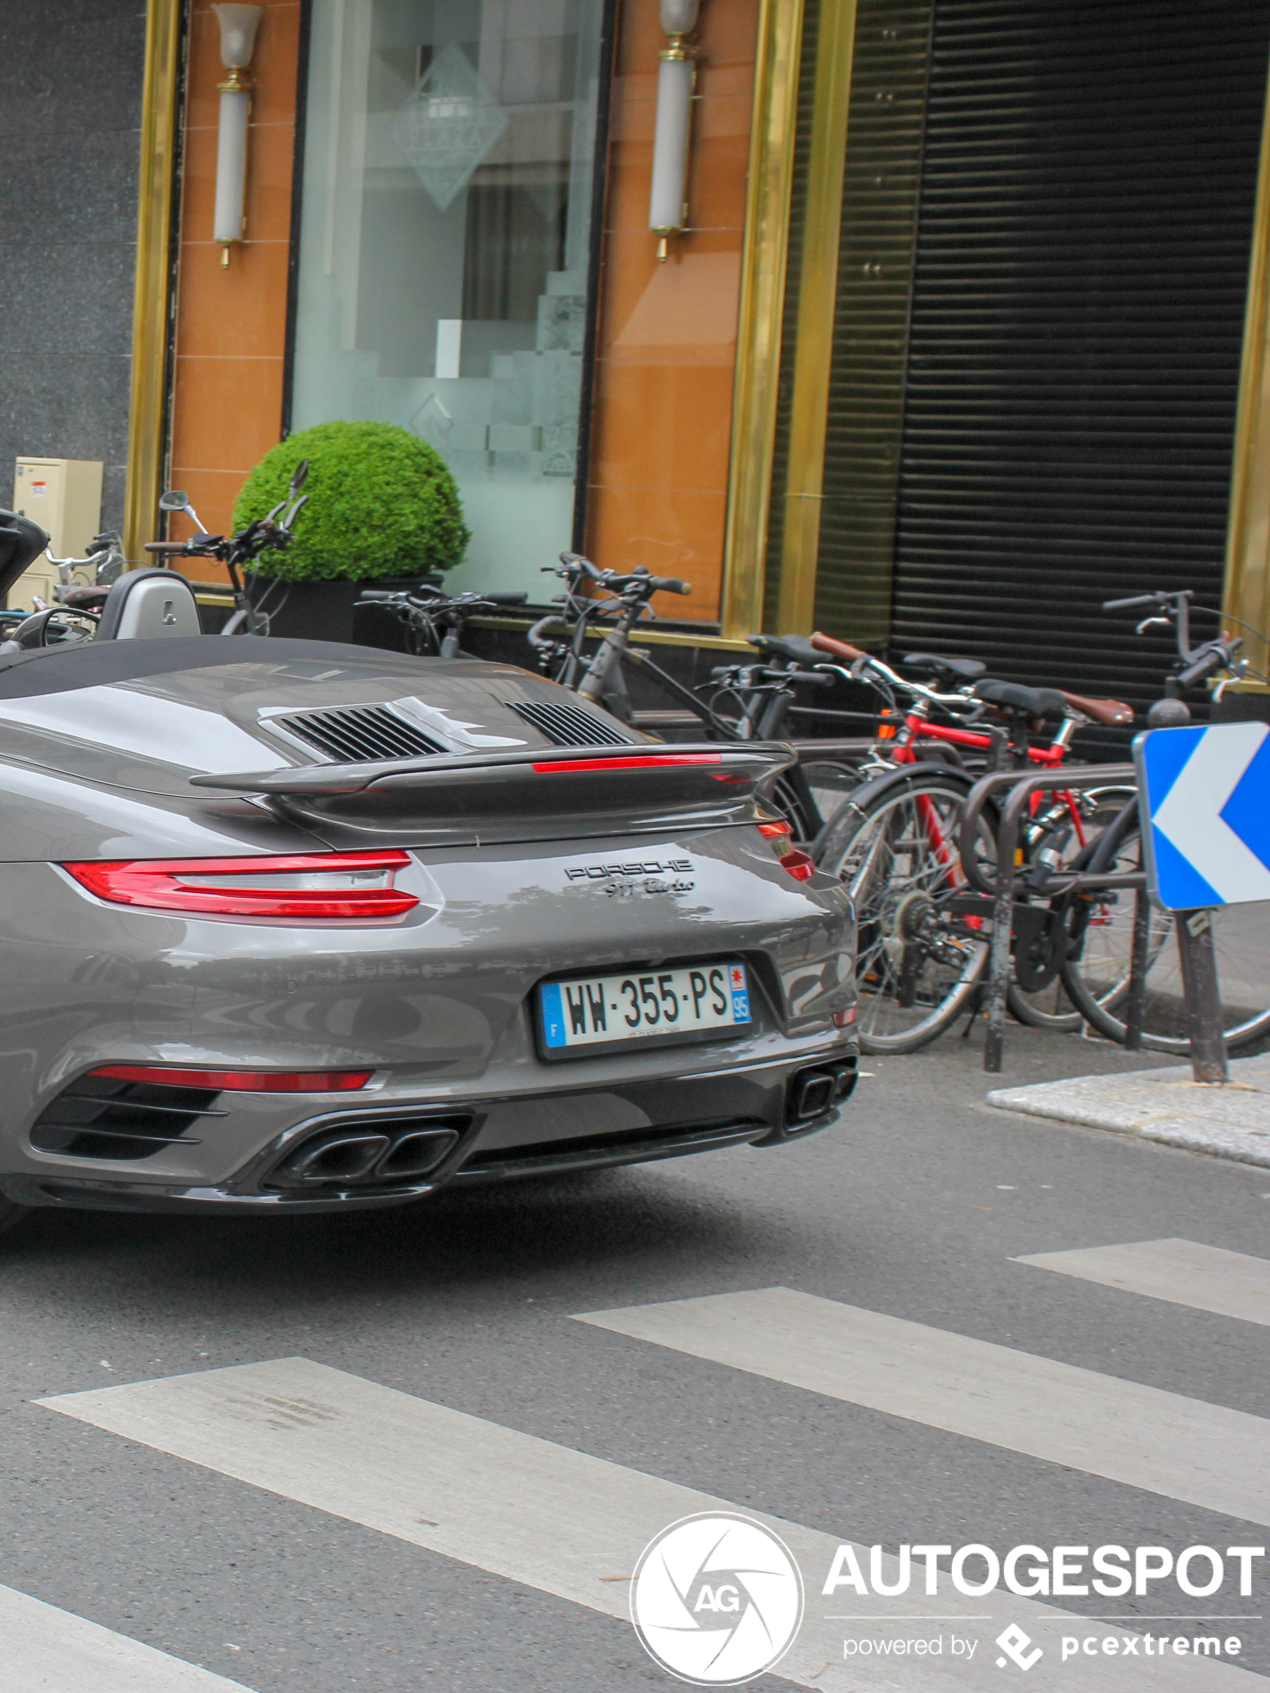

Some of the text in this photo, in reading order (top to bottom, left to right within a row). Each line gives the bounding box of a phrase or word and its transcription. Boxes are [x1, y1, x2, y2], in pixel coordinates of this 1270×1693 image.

[564, 859, 695, 880] PORSCHE
[605, 883, 635, 897] 911
[733, 996, 748, 1018] 95
[550, 1024, 557, 1037] F
